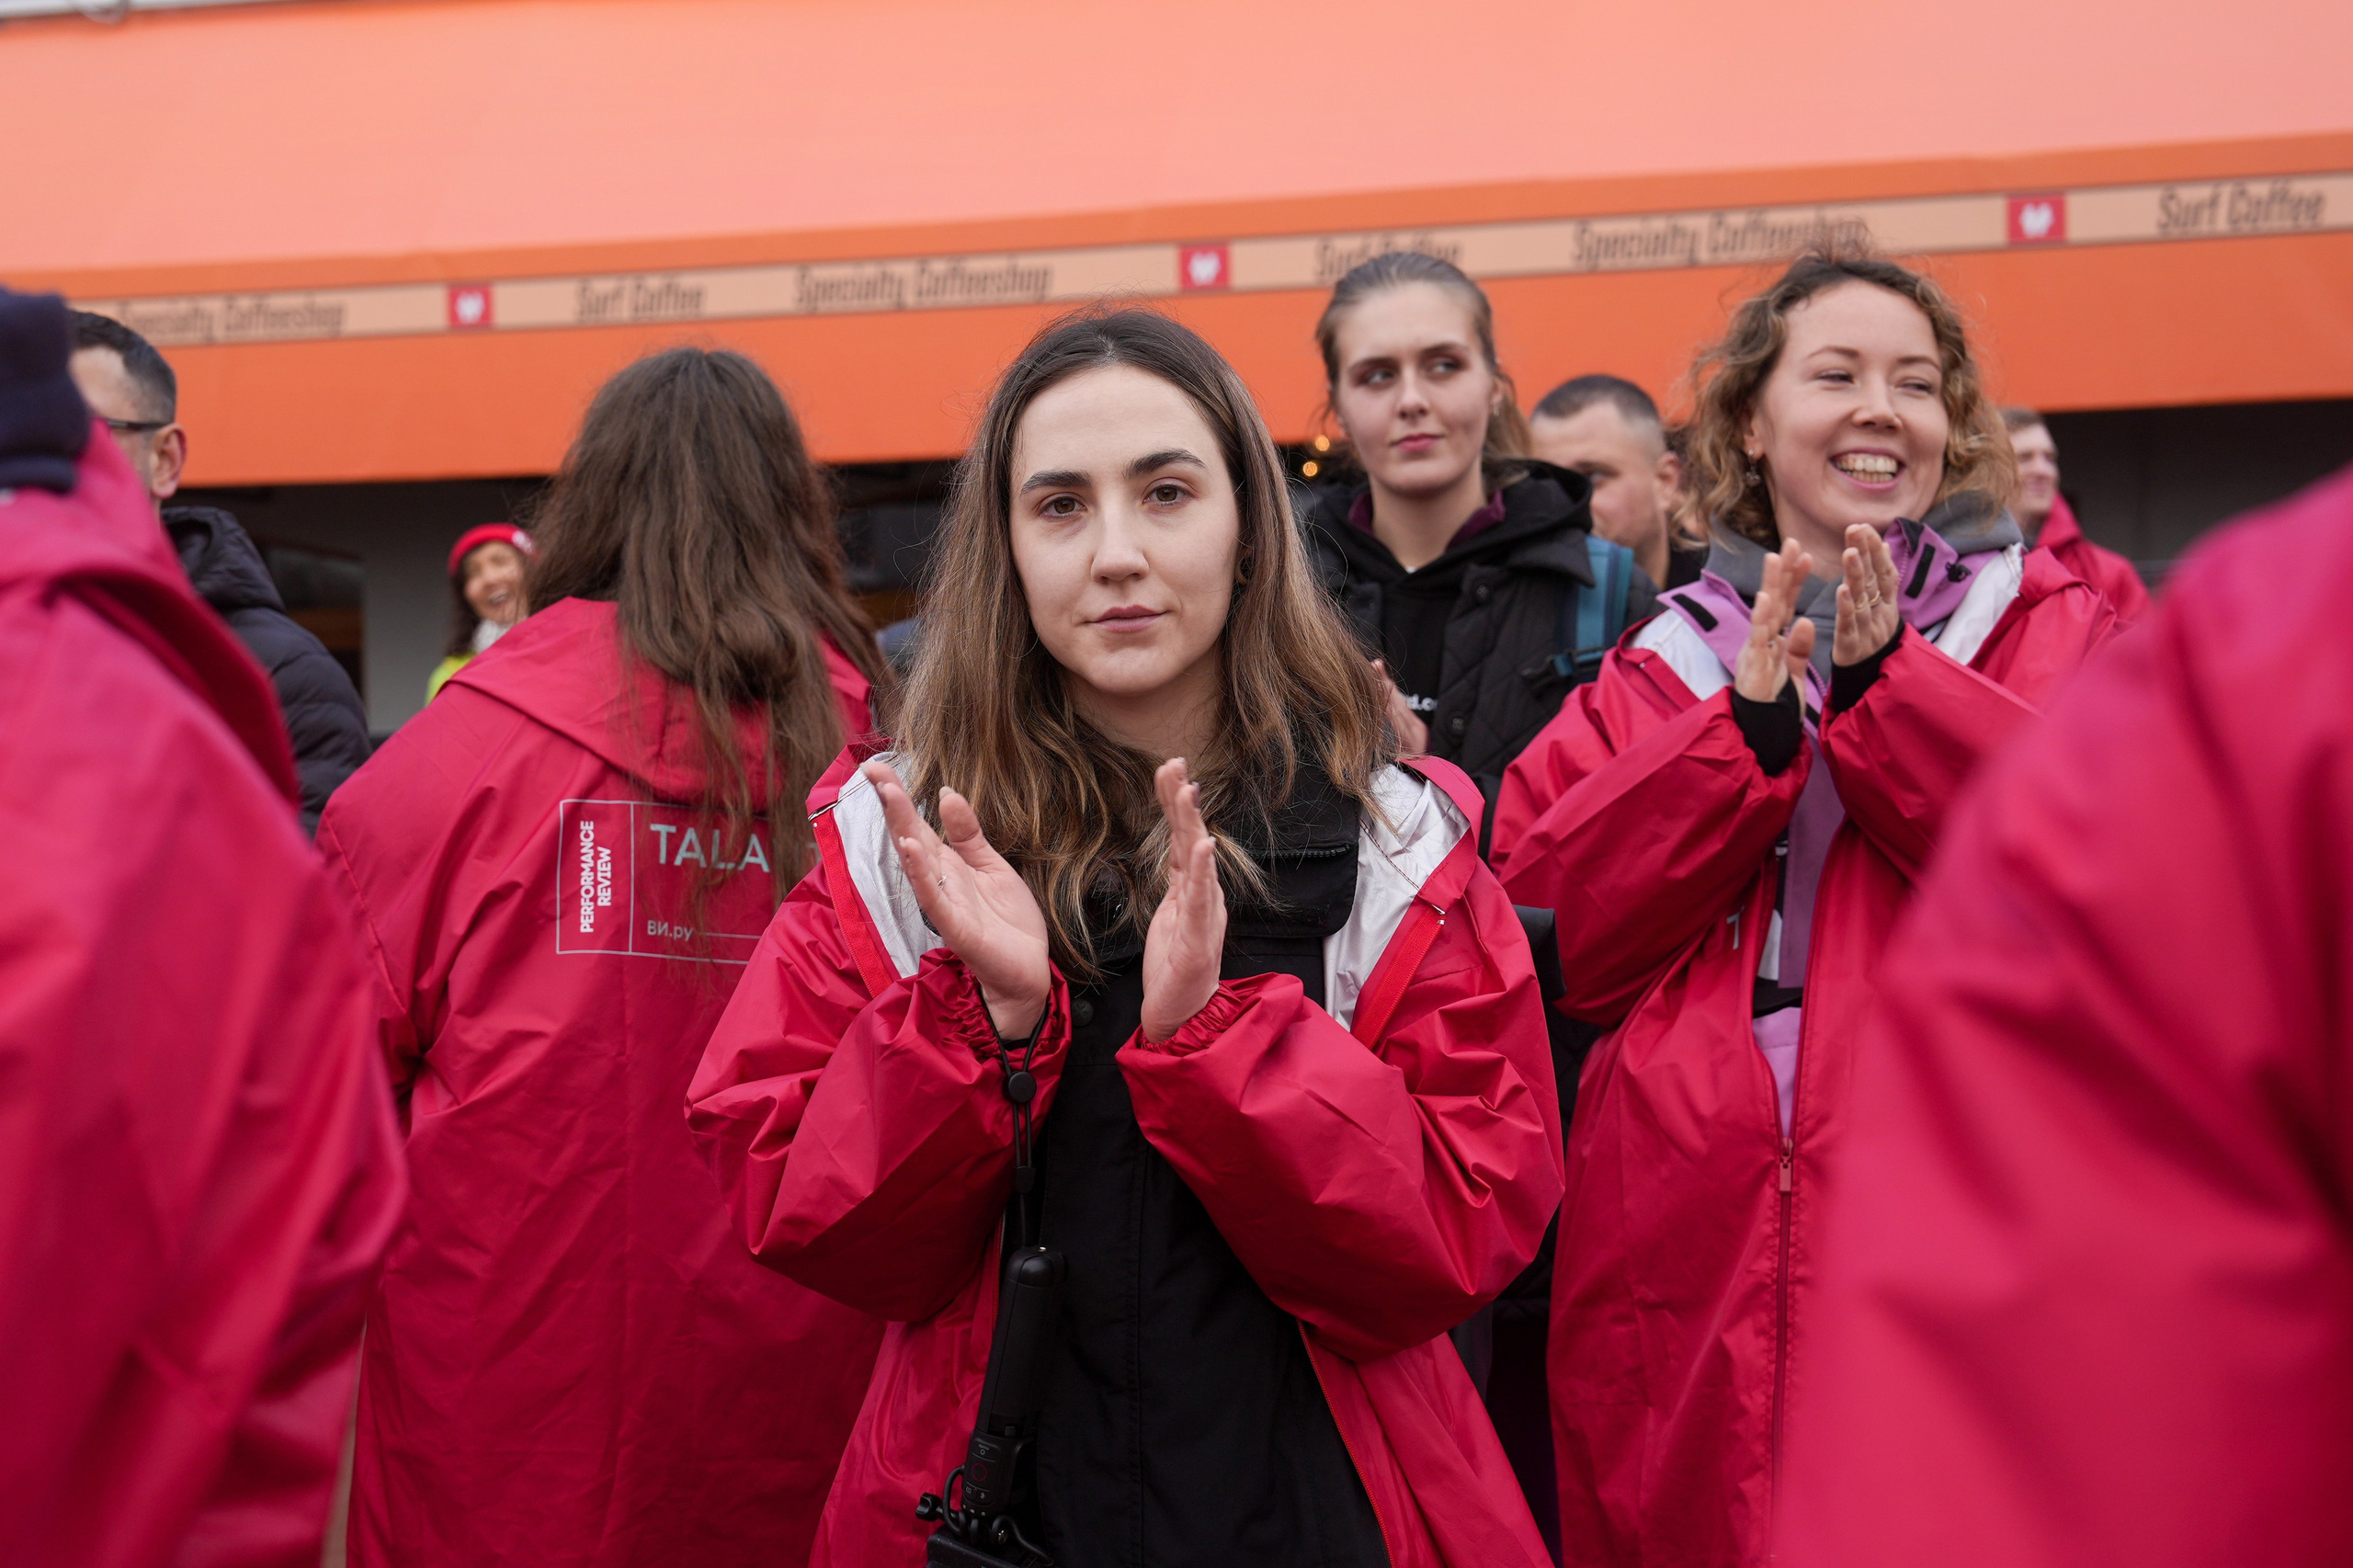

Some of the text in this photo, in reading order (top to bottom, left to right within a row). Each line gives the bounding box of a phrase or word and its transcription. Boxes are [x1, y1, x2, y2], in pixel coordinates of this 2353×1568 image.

[2156, 179, 2325, 232] Surf Coffee
[1571, 216, 1700, 270] Specialty
[576, 276, 703, 322] Surf Coffee
[794, 262, 907, 312] Specialty
[650, 823, 821, 874] TALA
[580, 820, 595, 933] PERFORMANCE
[597, 846, 611, 906] REVIEW
[646, 920, 693, 941] ВИ.ру
